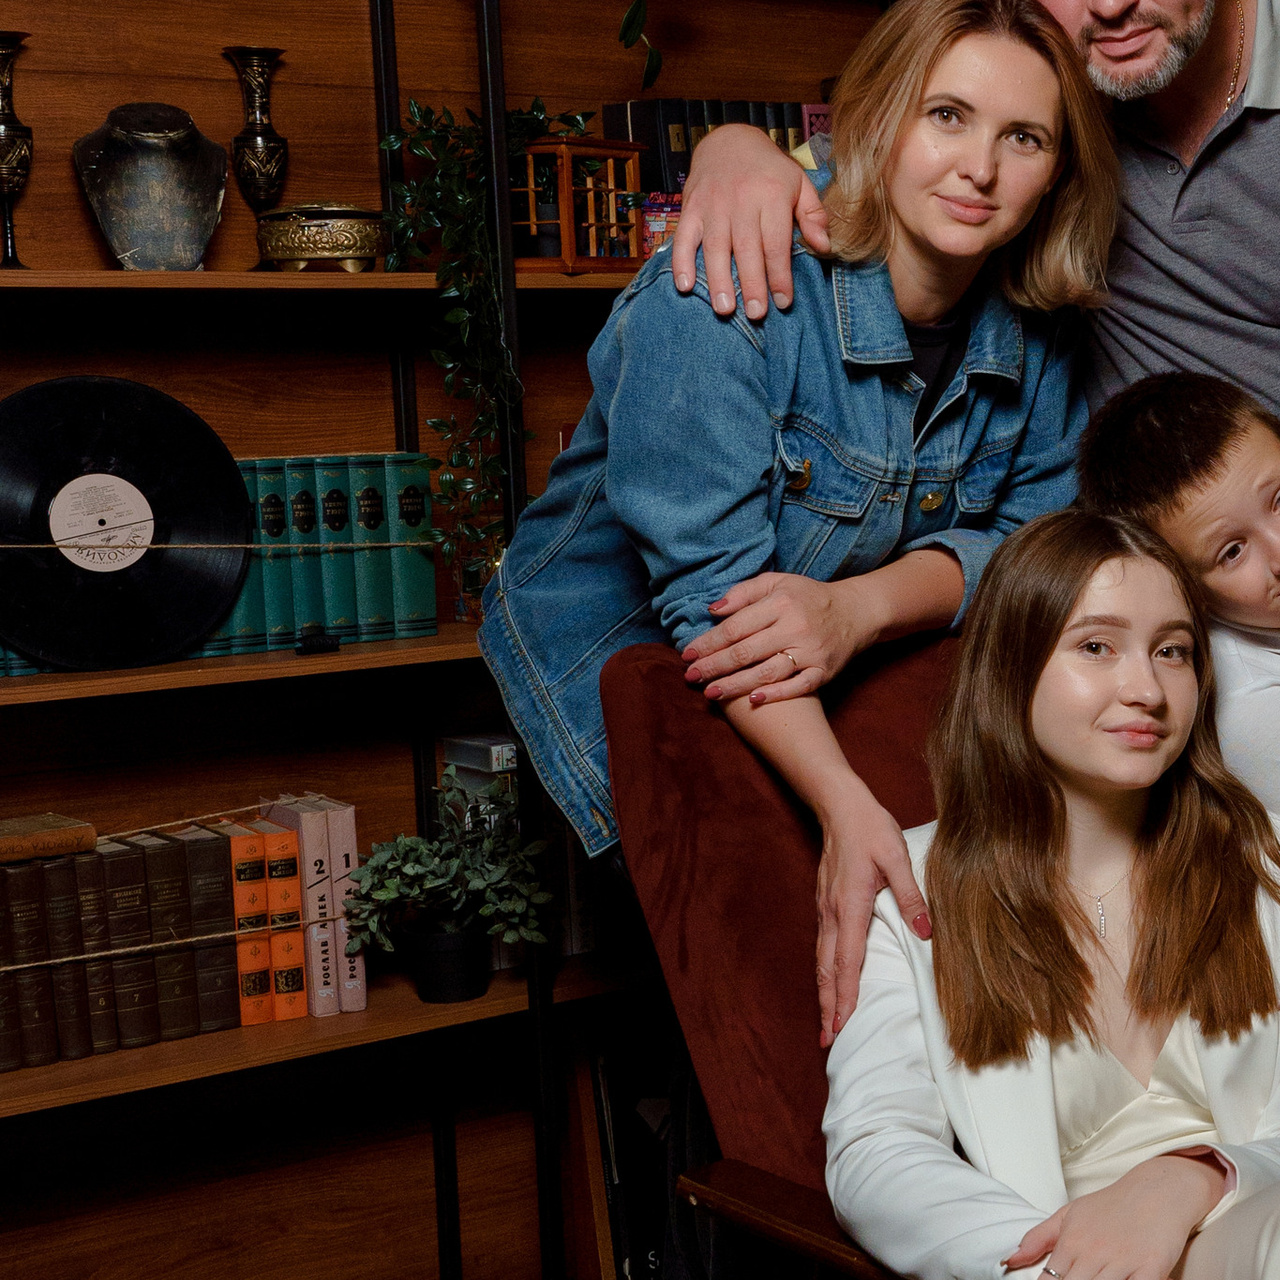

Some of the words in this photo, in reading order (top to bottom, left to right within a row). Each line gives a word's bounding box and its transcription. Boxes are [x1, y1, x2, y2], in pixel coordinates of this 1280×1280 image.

[314, 859, 325, 875] 2
[342, 853, 350, 868] 1
[312, 893, 330, 941] ГАШЕК
[318, 940, 334, 998] ЯРОСЛАВ
[99, 997, 106, 1006] 6
[133, 993, 140, 1002] 7
